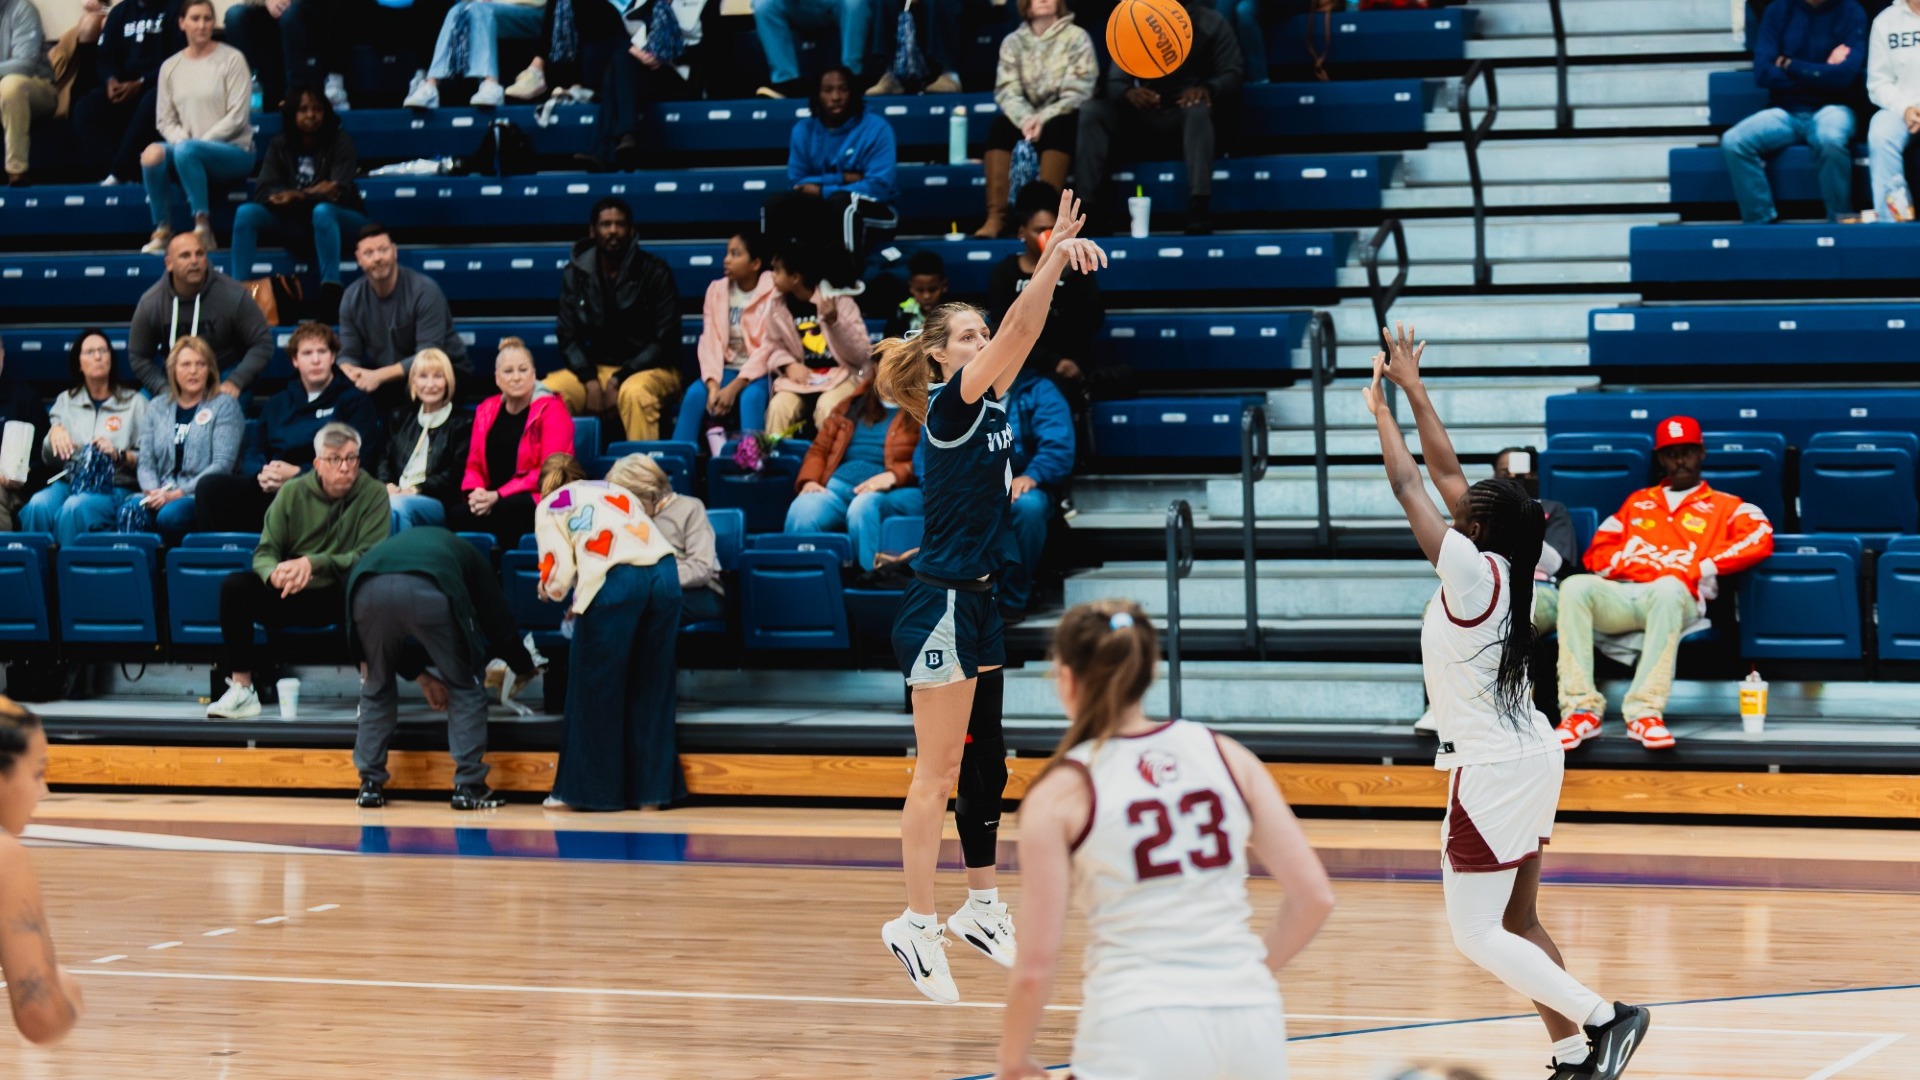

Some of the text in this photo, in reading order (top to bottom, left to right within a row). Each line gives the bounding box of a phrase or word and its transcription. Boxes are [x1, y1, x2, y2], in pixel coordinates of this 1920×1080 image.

[1145, 14, 1178, 67] Wilson
[928, 652, 940, 665] B
[1126, 789, 1233, 882] 23
